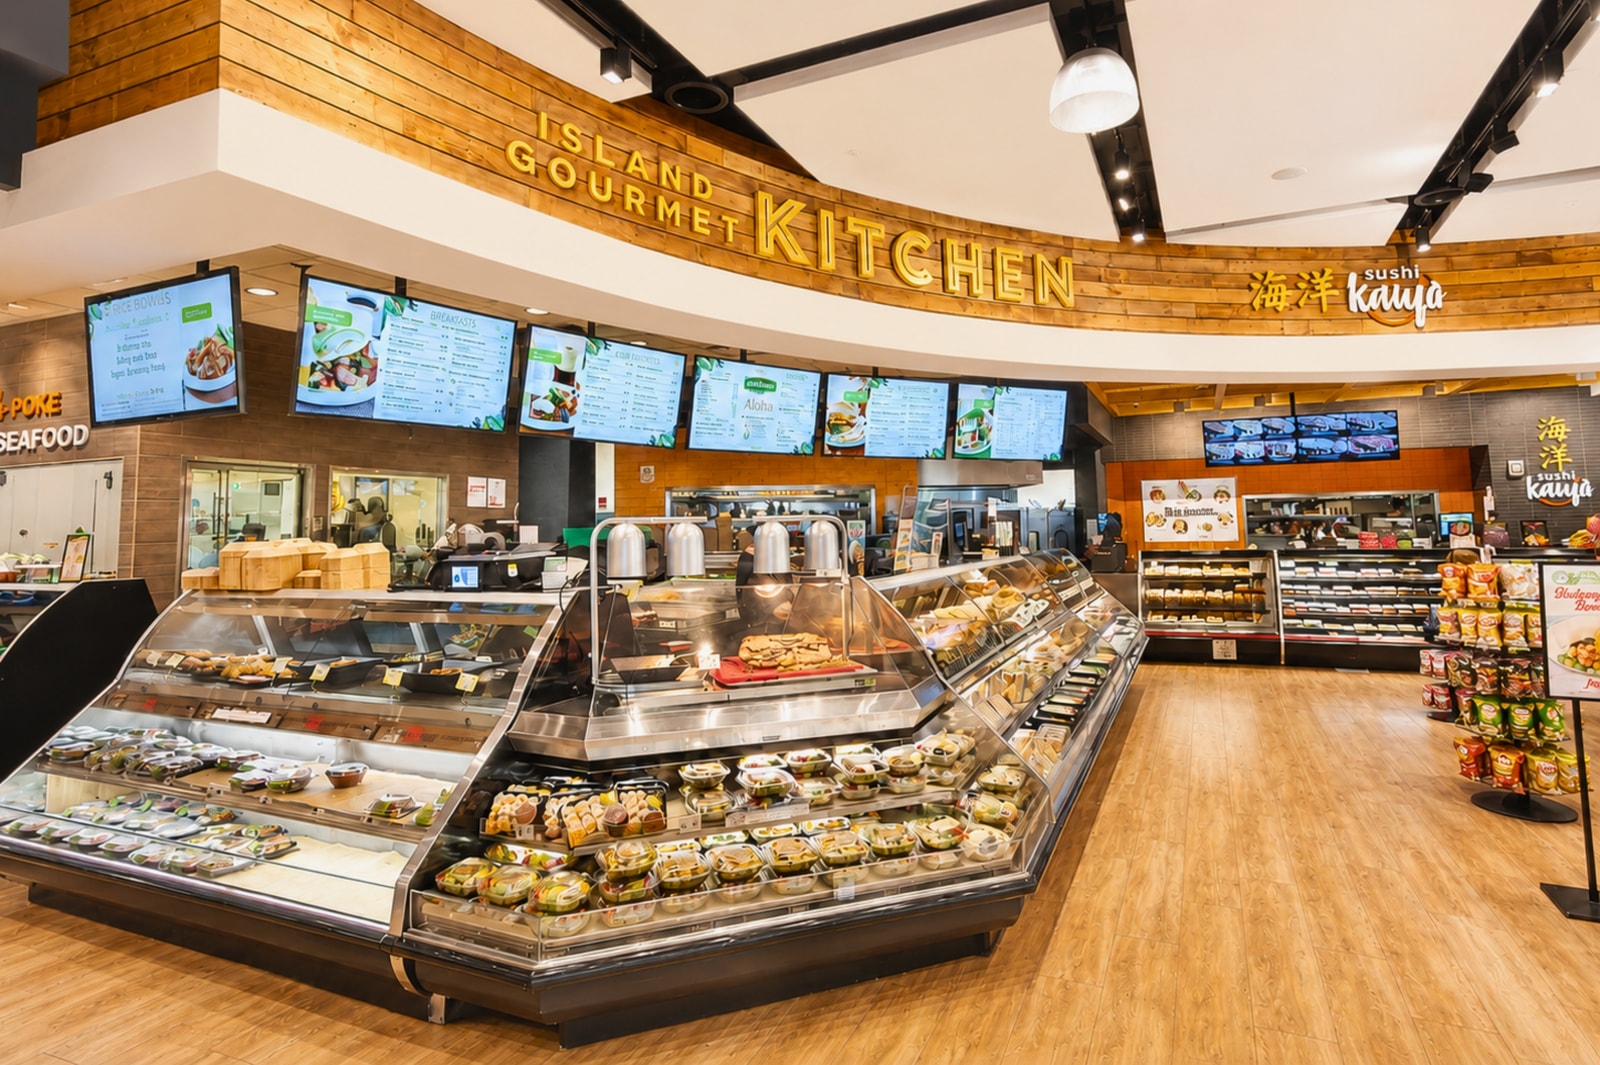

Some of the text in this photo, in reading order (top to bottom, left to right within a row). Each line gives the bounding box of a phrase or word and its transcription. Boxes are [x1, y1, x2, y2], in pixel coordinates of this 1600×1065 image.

[537, 112, 713, 200] ISLAND
[505, 140, 738, 243] GOURMET
[755, 190, 1075, 308] KITCHEN
[1249, 267, 1340, 313] 海洋
[1364, 264, 1420, 281] sushi
[11, 392, 62, 419] POKE
[743, 398, 774, 412] Aloha
[1537, 416, 1573, 472] 海洋
[1537, 470, 1576, 481] sushi
